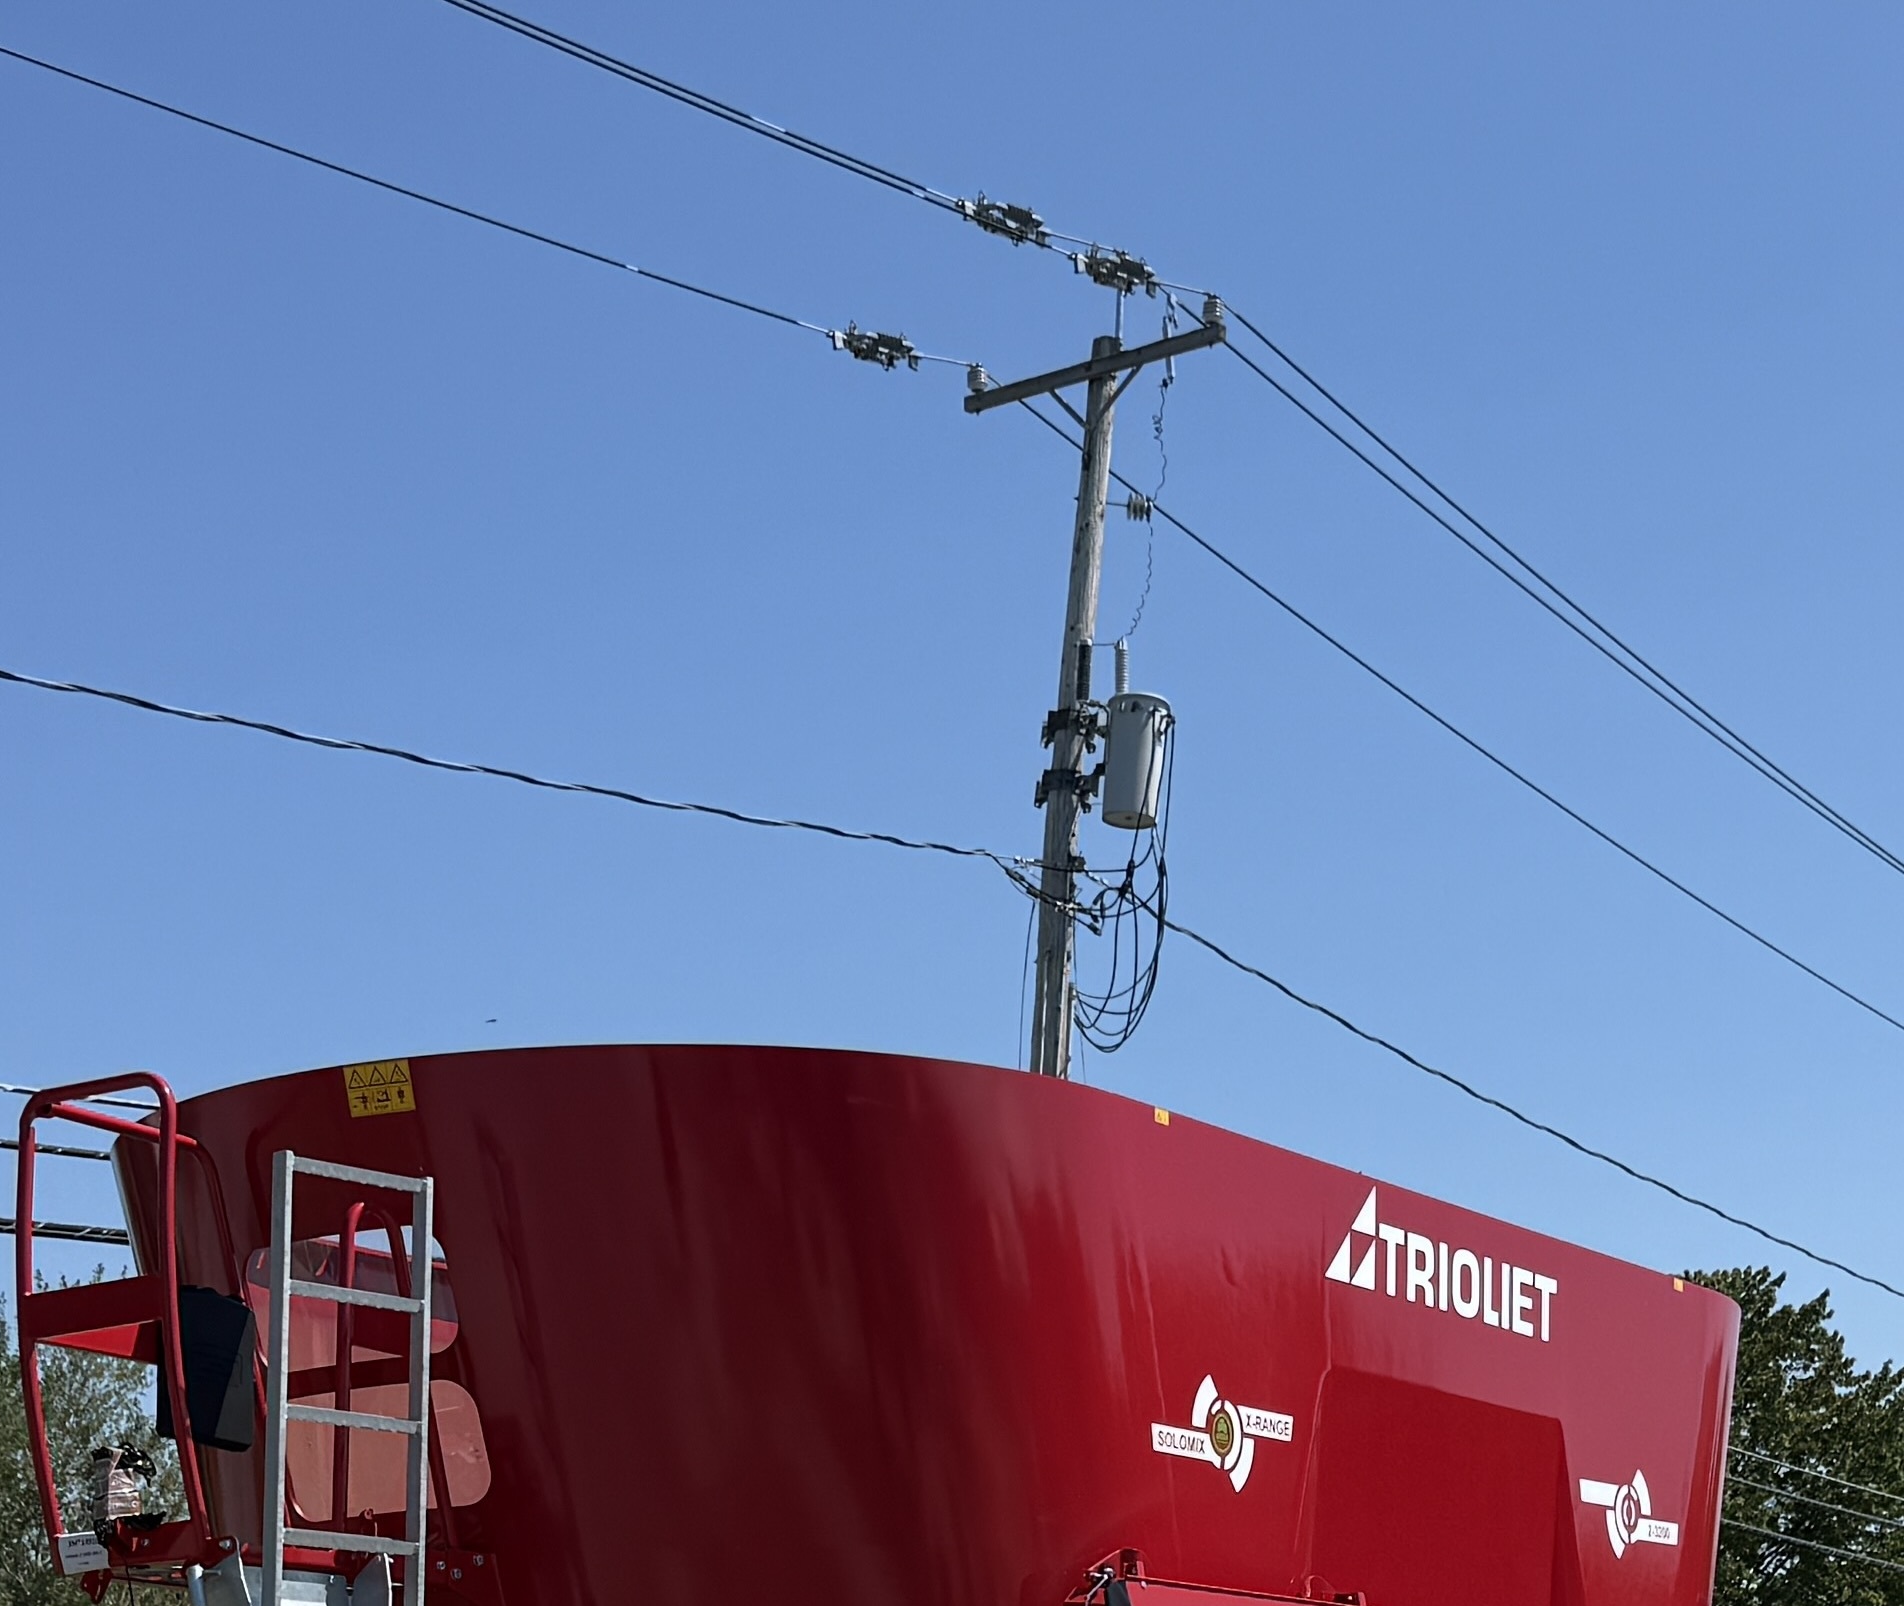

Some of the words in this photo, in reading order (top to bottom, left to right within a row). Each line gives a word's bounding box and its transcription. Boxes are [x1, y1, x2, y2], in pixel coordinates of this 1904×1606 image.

[1378, 1222, 1558, 1342] TRIOLIET
[1245, 1414, 1290, 1437] X-RANGE
[1158, 1430, 1206, 1454] SOLOMIX
